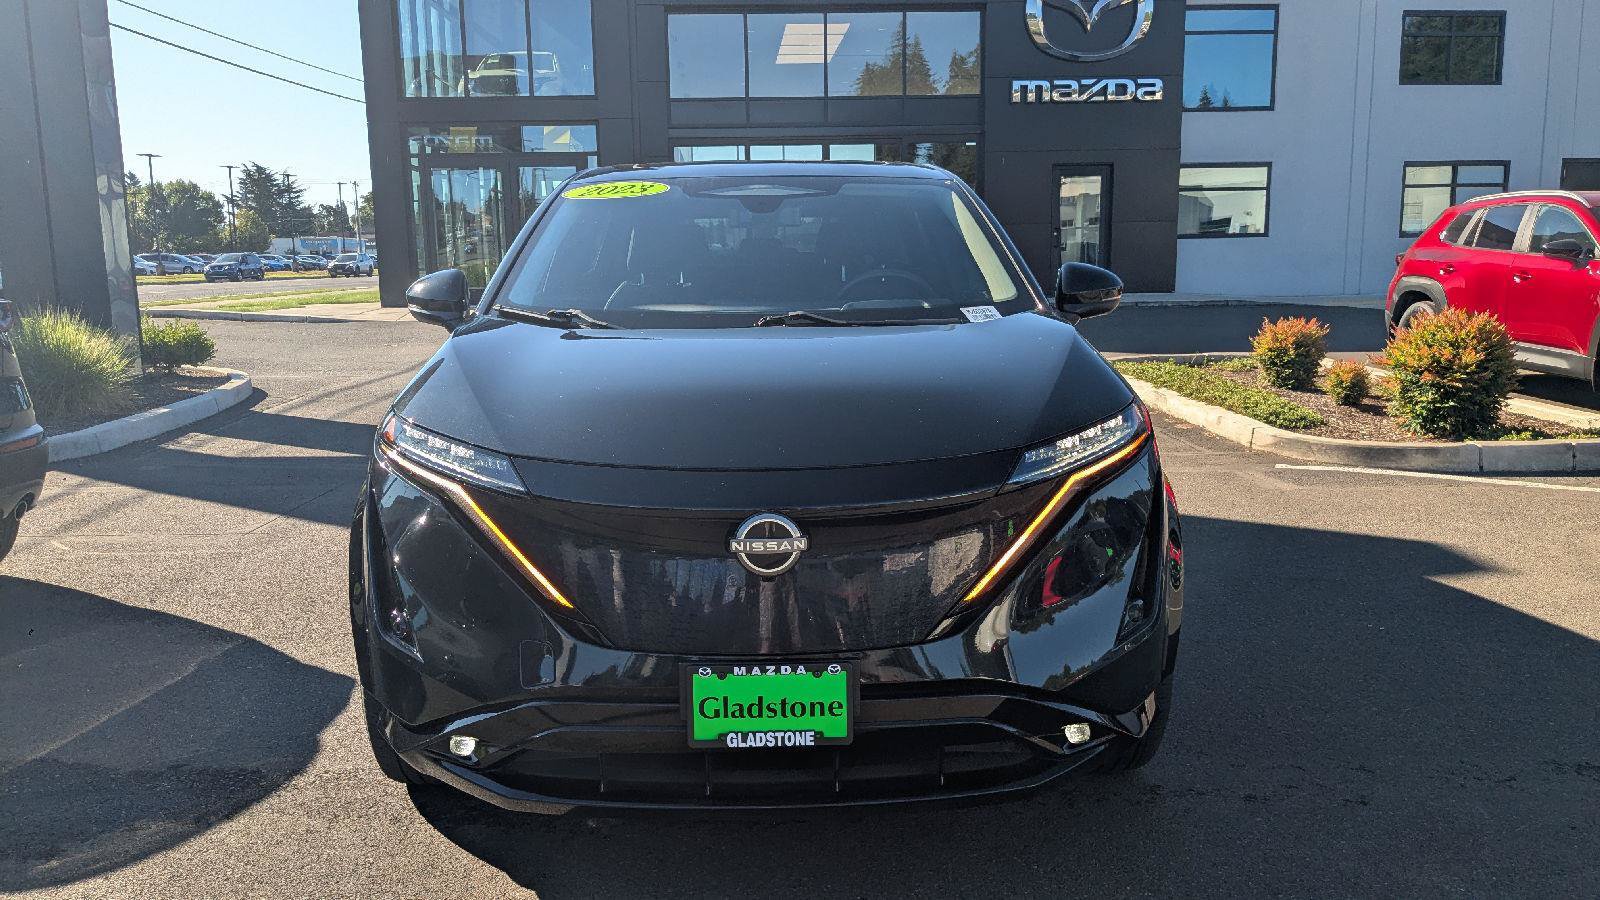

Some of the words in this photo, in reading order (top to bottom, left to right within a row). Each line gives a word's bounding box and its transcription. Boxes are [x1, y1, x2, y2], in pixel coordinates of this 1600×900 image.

[577, 184, 655, 197] 2023
[731, 540, 805, 551] NISSAN
[733, 665, 807, 676] MAZDA
[698, 695, 844, 720] Gladstone
[726, 731, 815, 748] GLADSTONE
